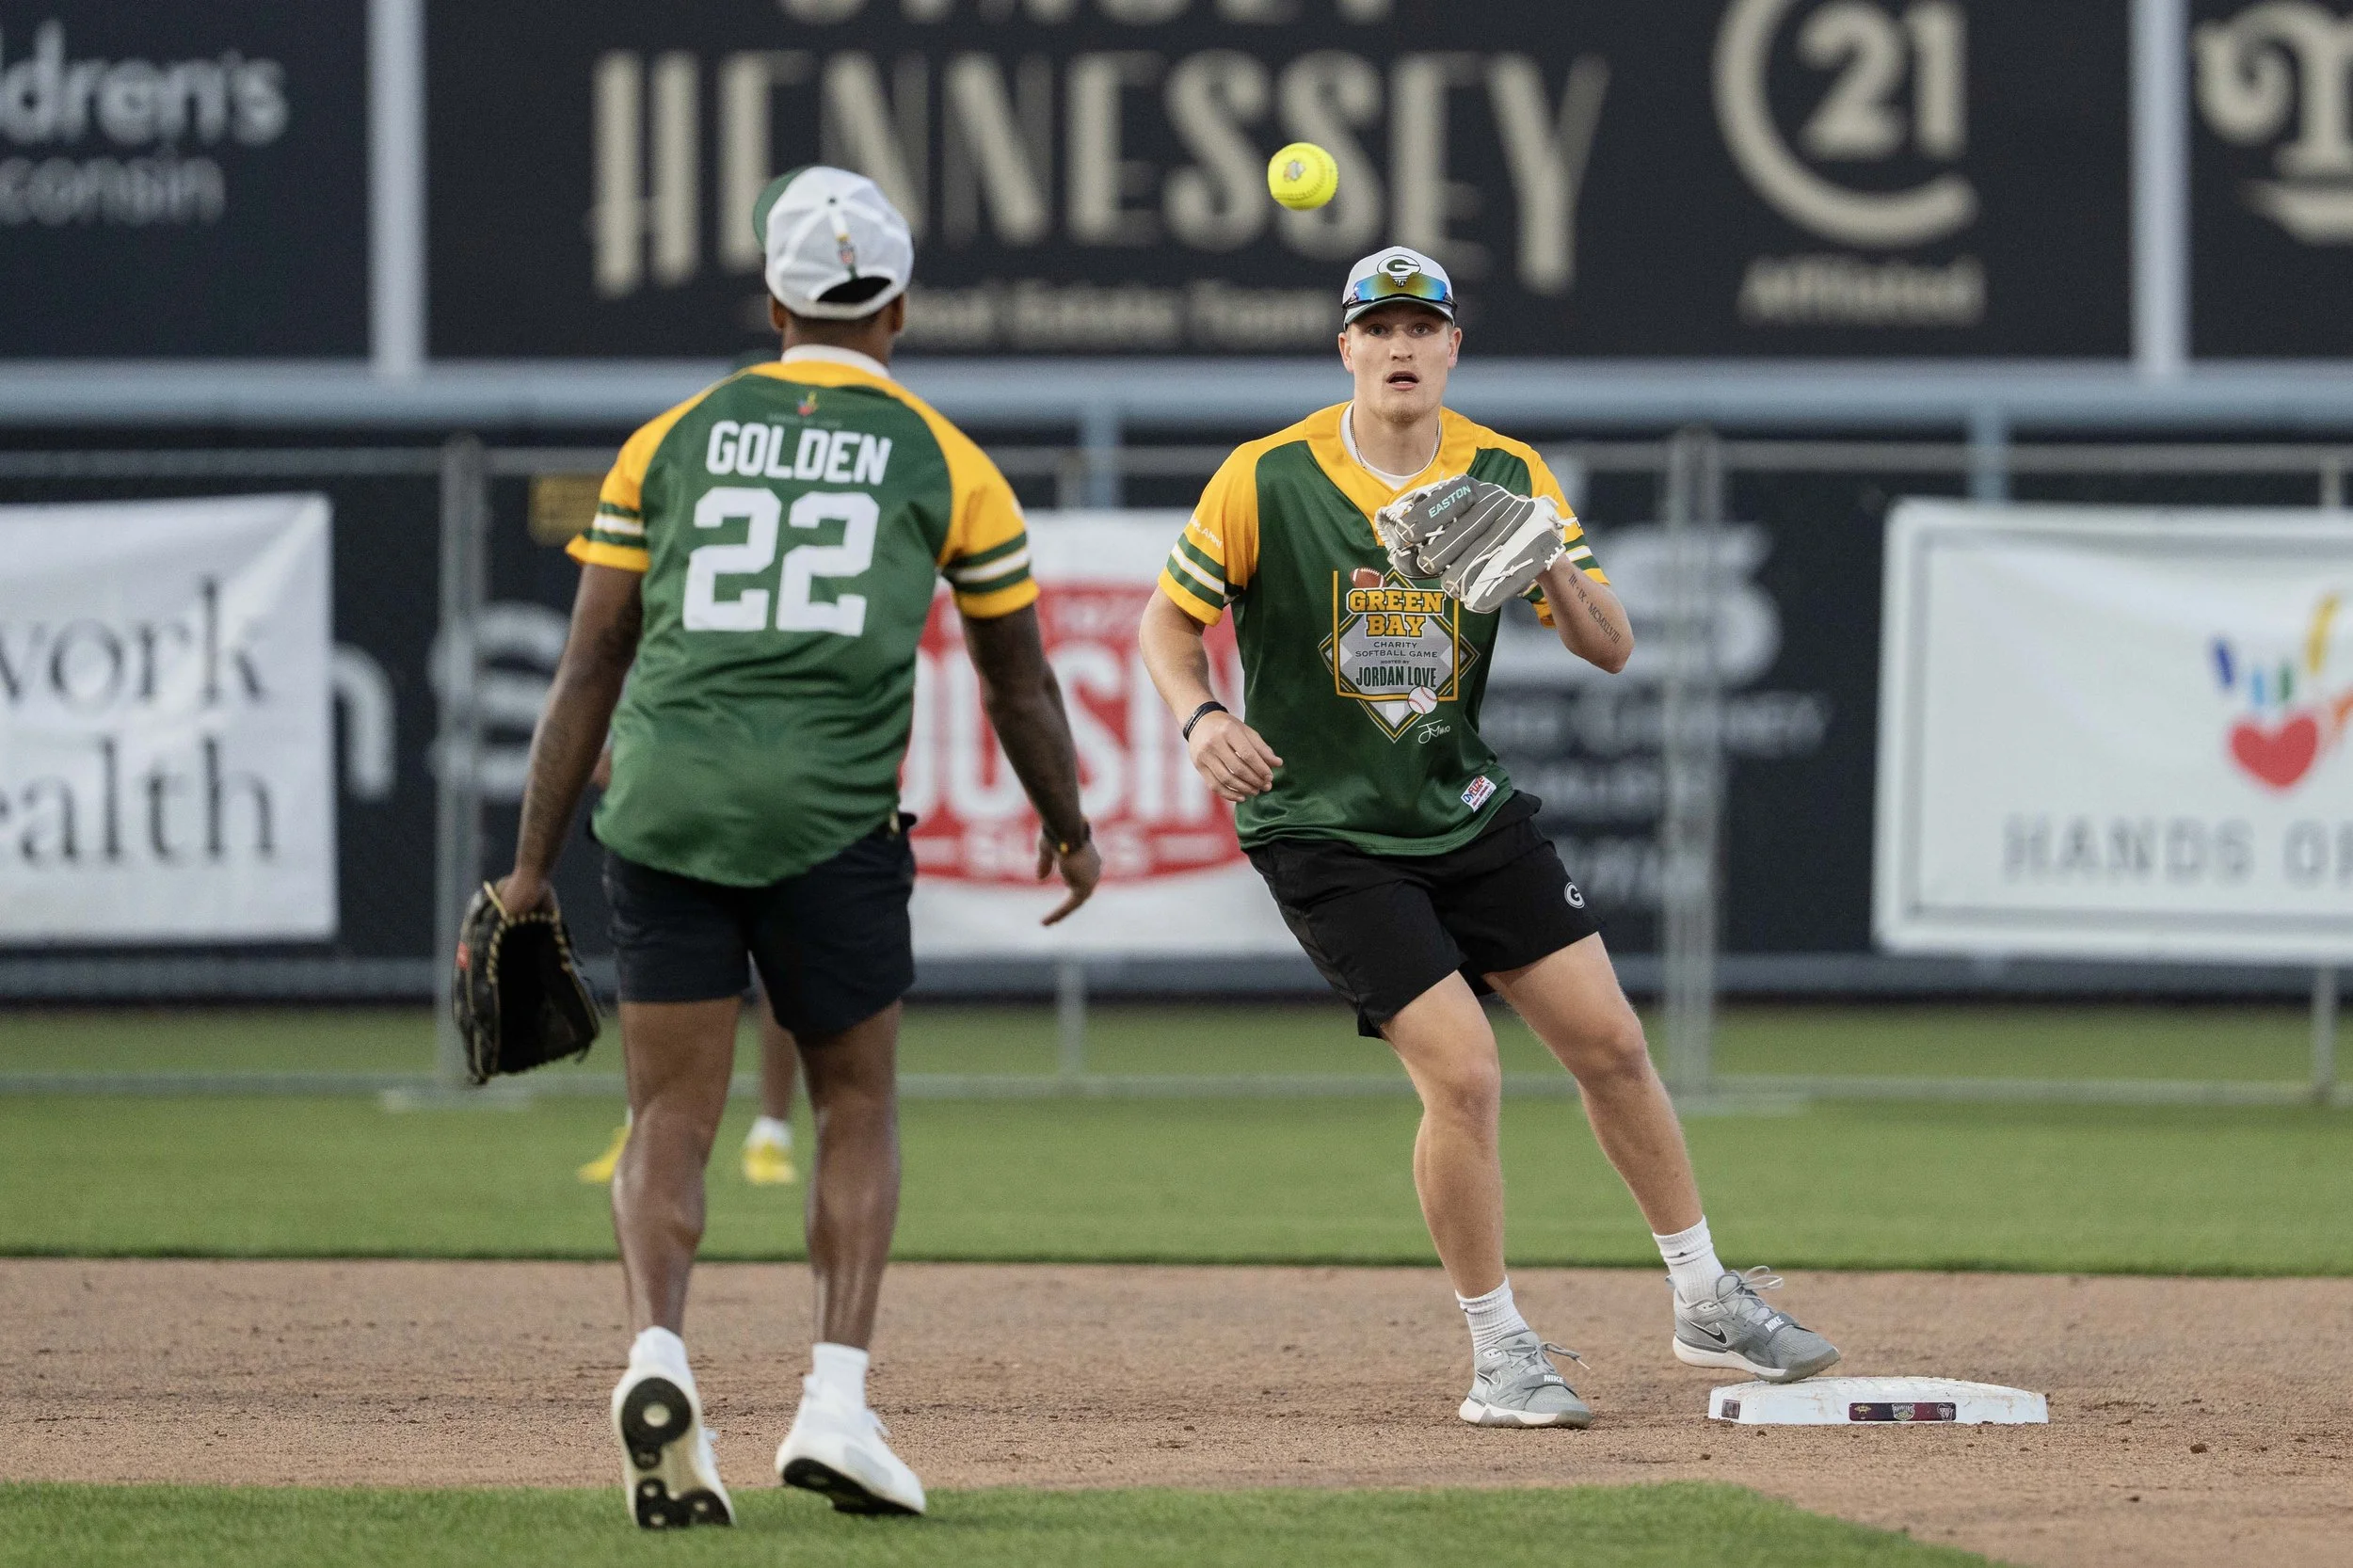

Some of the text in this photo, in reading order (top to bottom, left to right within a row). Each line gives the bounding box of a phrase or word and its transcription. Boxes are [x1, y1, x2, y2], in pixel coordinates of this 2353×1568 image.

[1797, 4, 1969, 158] 21
[589, 51, 1610, 298] HENNESSEY
[706, 421, 892, 485] GOLDEN
[1428, 485, 1471, 519] EASTON
[682, 488, 880, 637] 22
[1348, 589, 1446, 614] GREEN
[1366, 615, 1426, 637] BAY
[1355, 665, 1437, 687] JORDAN LOVE
[0, 735, 277, 864] alth
[2003, 813, 2255, 886] HANDS
[1564, 881, 1585, 909] G
[1765, 1315, 1785, 1332] NIKE
[1544, 1374, 1564, 1384] NIKE
